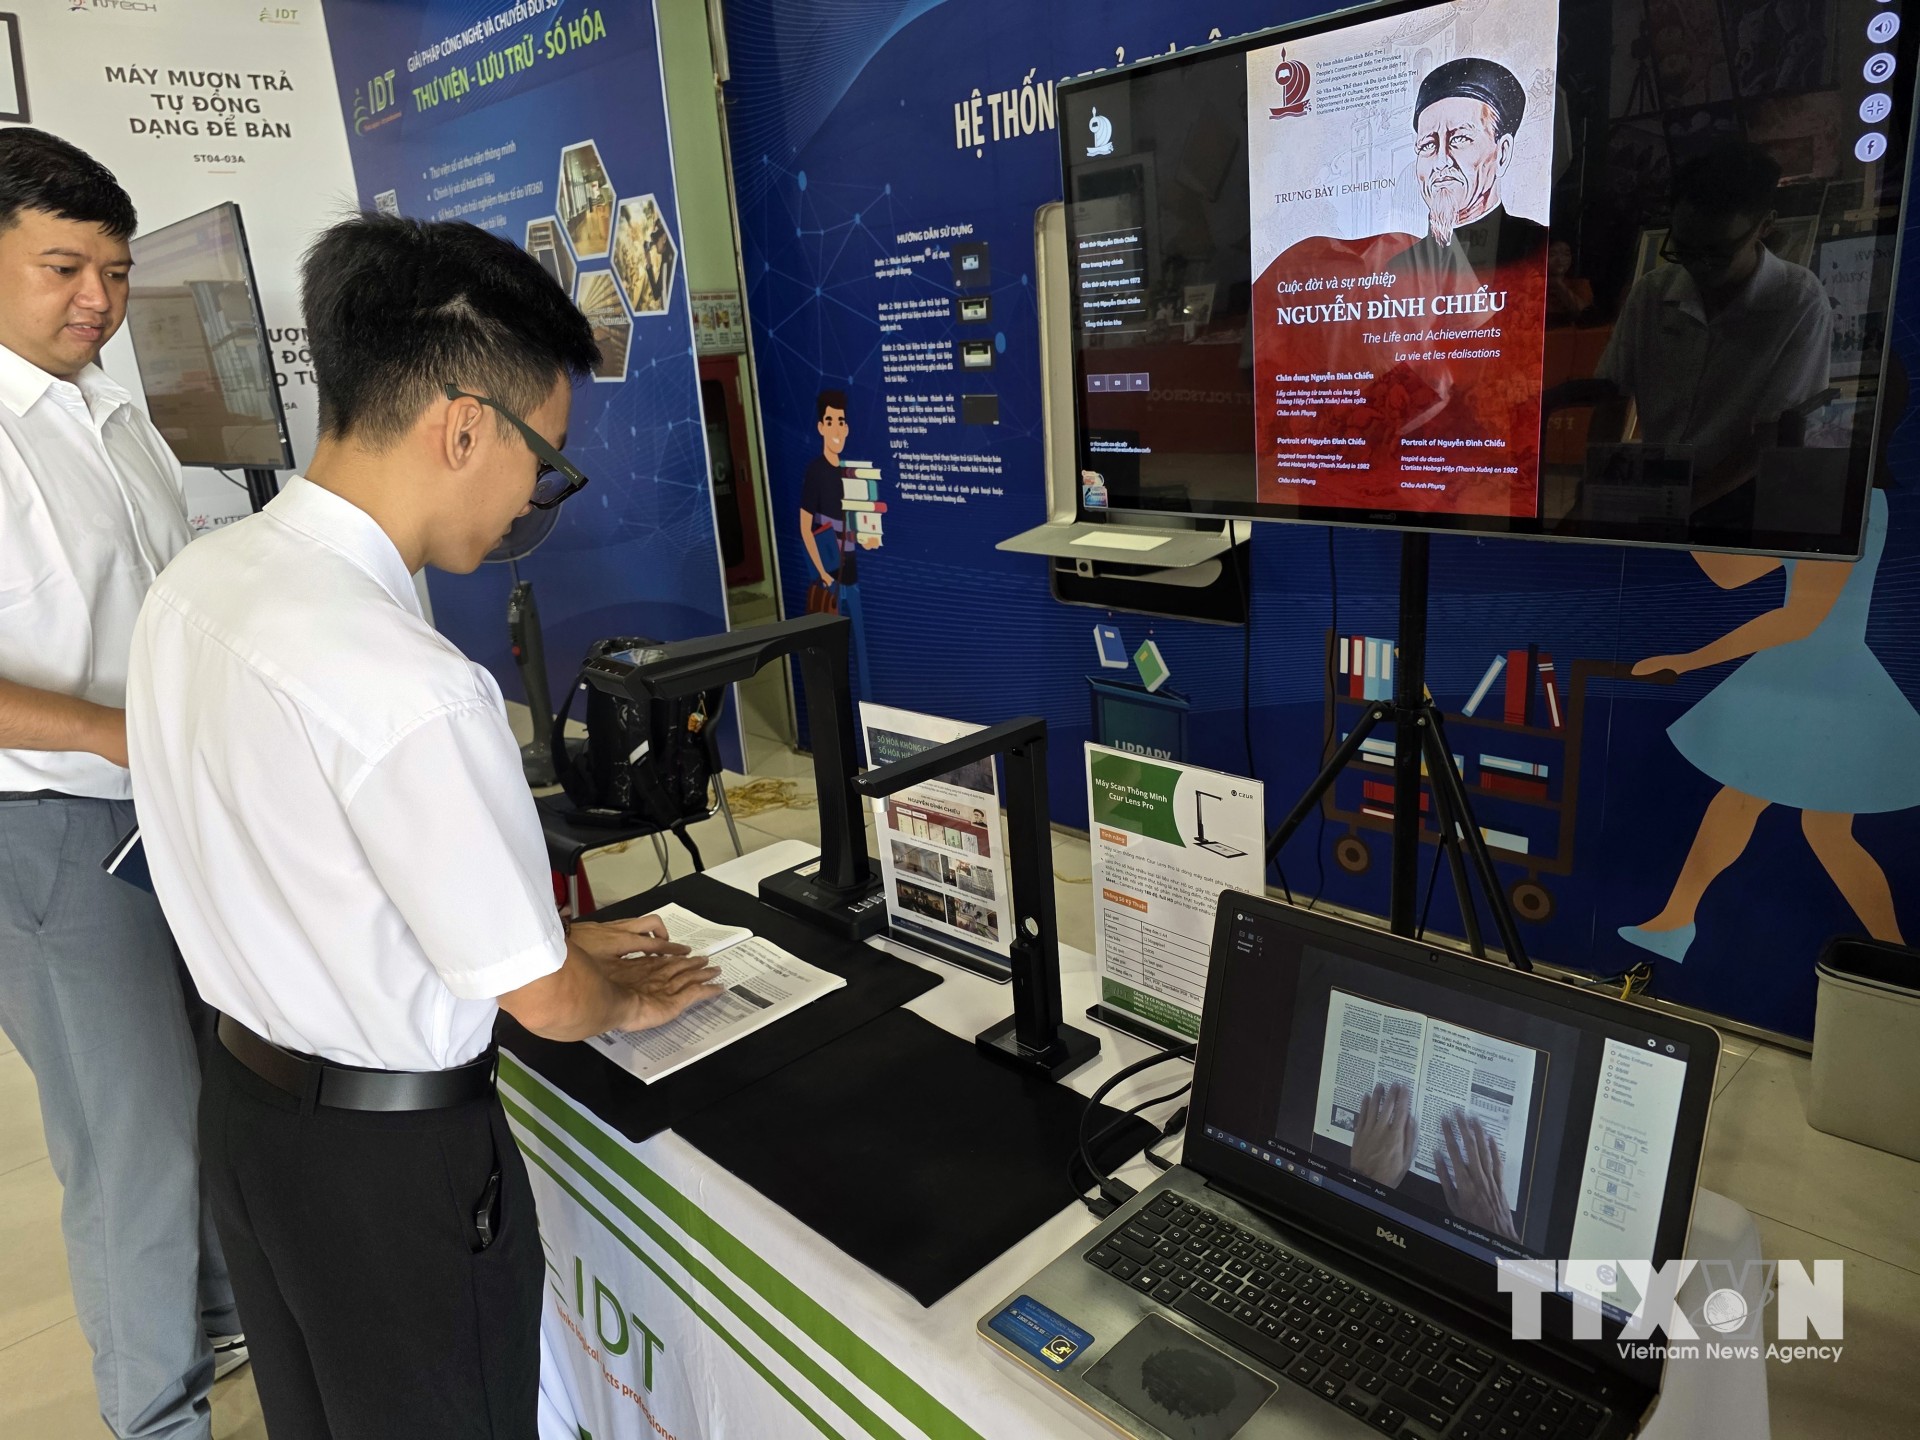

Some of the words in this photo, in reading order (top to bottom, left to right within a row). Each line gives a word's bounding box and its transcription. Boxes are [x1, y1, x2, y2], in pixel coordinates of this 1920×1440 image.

[275, 9, 298, 20] IDT
[407, 50, 422, 72] GIẢI
[422, 44, 440, 64] PHÁP
[441, 32, 462, 56] CÔNG
[462, 20, 484, 44] NGHỆ
[483, 16, 494, 37] VÀ
[413, 83, 440, 112] THƯ
[440, 66, 470, 103] VIỆN
[476, 51, 504, 86] LƯU
[504, 34, 534, 74] TRỮ
[545, 16, 567, 60] SỐ
[569, 8, 606, 49] HÓA
[105, 64, 158, 85] MÁY
[168, 69, 241, 92] MƯỢN
[248, 70, 294, 92] TRẢ
[367, 69, 396, 114] IDT
[151, 94, 184, 115] TỰ
[192, 91, 261, 115] ĐỘNG
[954, 88, 985, 158] HỆ
[987, 67, 1059, 141] THỐN
[129, 118, 199, 140] DẠNG
[246, 120, 292, 138] BÀN
[193, 154, 245, 164] ST04-03A
[1275, 189, 1312, 204] TRƯNG
[1314, 185, 1334, 198] BÀY
[1341, 178, 1396, 194] EXHIBITION
[1277, 280, 1303, 294] Cuộc
[1305, 277, 1323, 292] đời
[1326, 277, 1338, 289] và
[1341, 278, 1356, 288] sự
[1358, 272, 1396, 288] nghiệp
[1277, 295, 1362, 325] NGUYỄN
[1367, 295, 1425, 320] ĐÌNH
[1431, 284, 1507, 315] CHIỂU
[1362, 333, 1381, 344] The
[1383, 332, 1401, 343] Life
[1403, 330, 1423, 342] and
[1425, 327, 1501, 341] Achievements
[1395, 351, 1406, 362] La
[1408, 351, 1421, 361] vie
[1422, 351, 1431, 360] et
[1433, 349, 1445, 360] les
[1448, 348, 1500, 359] réalisations
[1276, 374, 1292, 382] Chân
[1293, 374, 1309, 382] dung
[1311, 372, 1335, 382] Nguyễn
[1337, 372, 1352, 380] Đình
[1354, 371, 1374, 379] Chiểu
[1308, 438, 1331, 446] Nguyễn
[1348, 438, 1366, 446] Chiểu
[1438, 439, 1464, 447] Nguyễn
[1466, 439, 1482, 447] Đình
[1484, 439, 1505, 447] Chiểu
[1442, 465, 1455, 473] Hiệp
[886, 738, 899, 747] HÓA
[1095, 778, 1110, 789] Máy
[1110, 782, 1126, 792] Scan
[1127, 785, 1149, 799] Thông
[1149, 791, 1168, 803] Minh
[1109, 793, 1124, 802] Czur
[1125, 796, 1141, 807] Lens
[1142, 800, 1154, 810] Pro
[1376, 1226, 1407, 1249] DELL
[1452, 1222, 1467, 1232] Video
[574, 1255, 664, 1395] IDT
